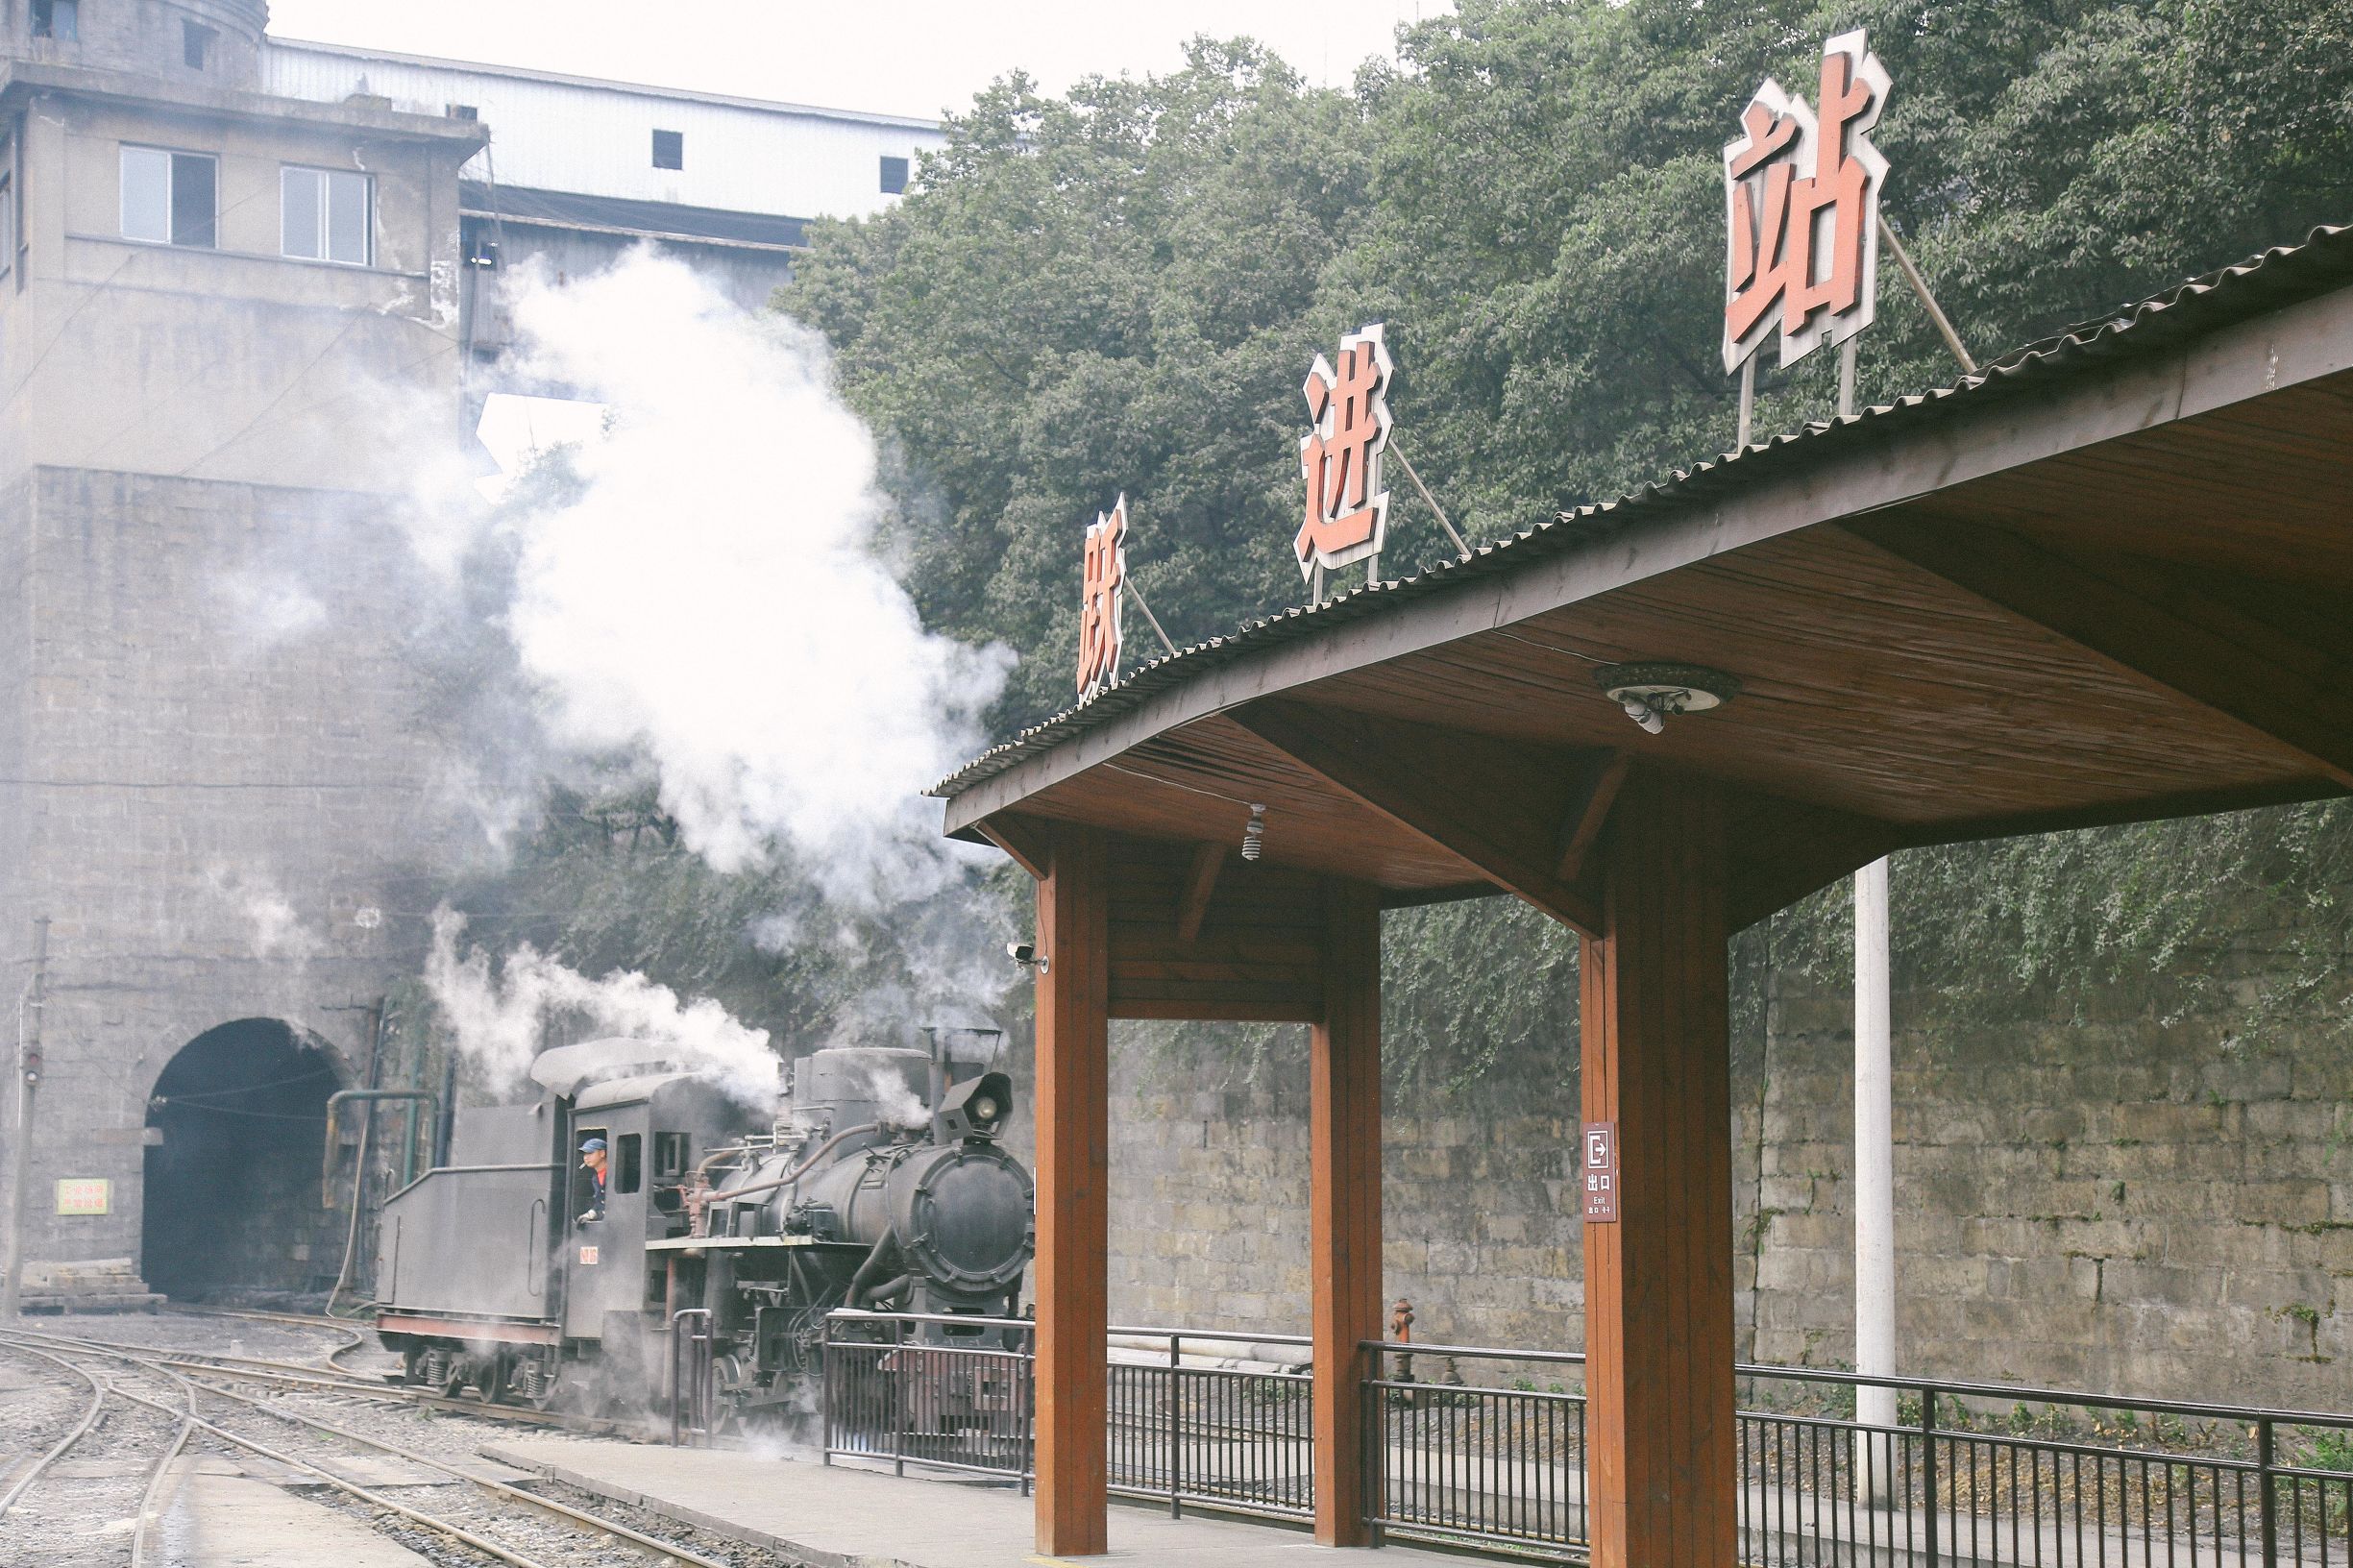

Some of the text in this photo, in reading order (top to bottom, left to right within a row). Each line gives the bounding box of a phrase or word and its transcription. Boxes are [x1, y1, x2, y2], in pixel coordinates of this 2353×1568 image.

[1076, 50, 1872, 695] 跃进站
[1587, 1173, 1610, 1191] 出口
[1593, 1196, 1605, 1205] Exit
